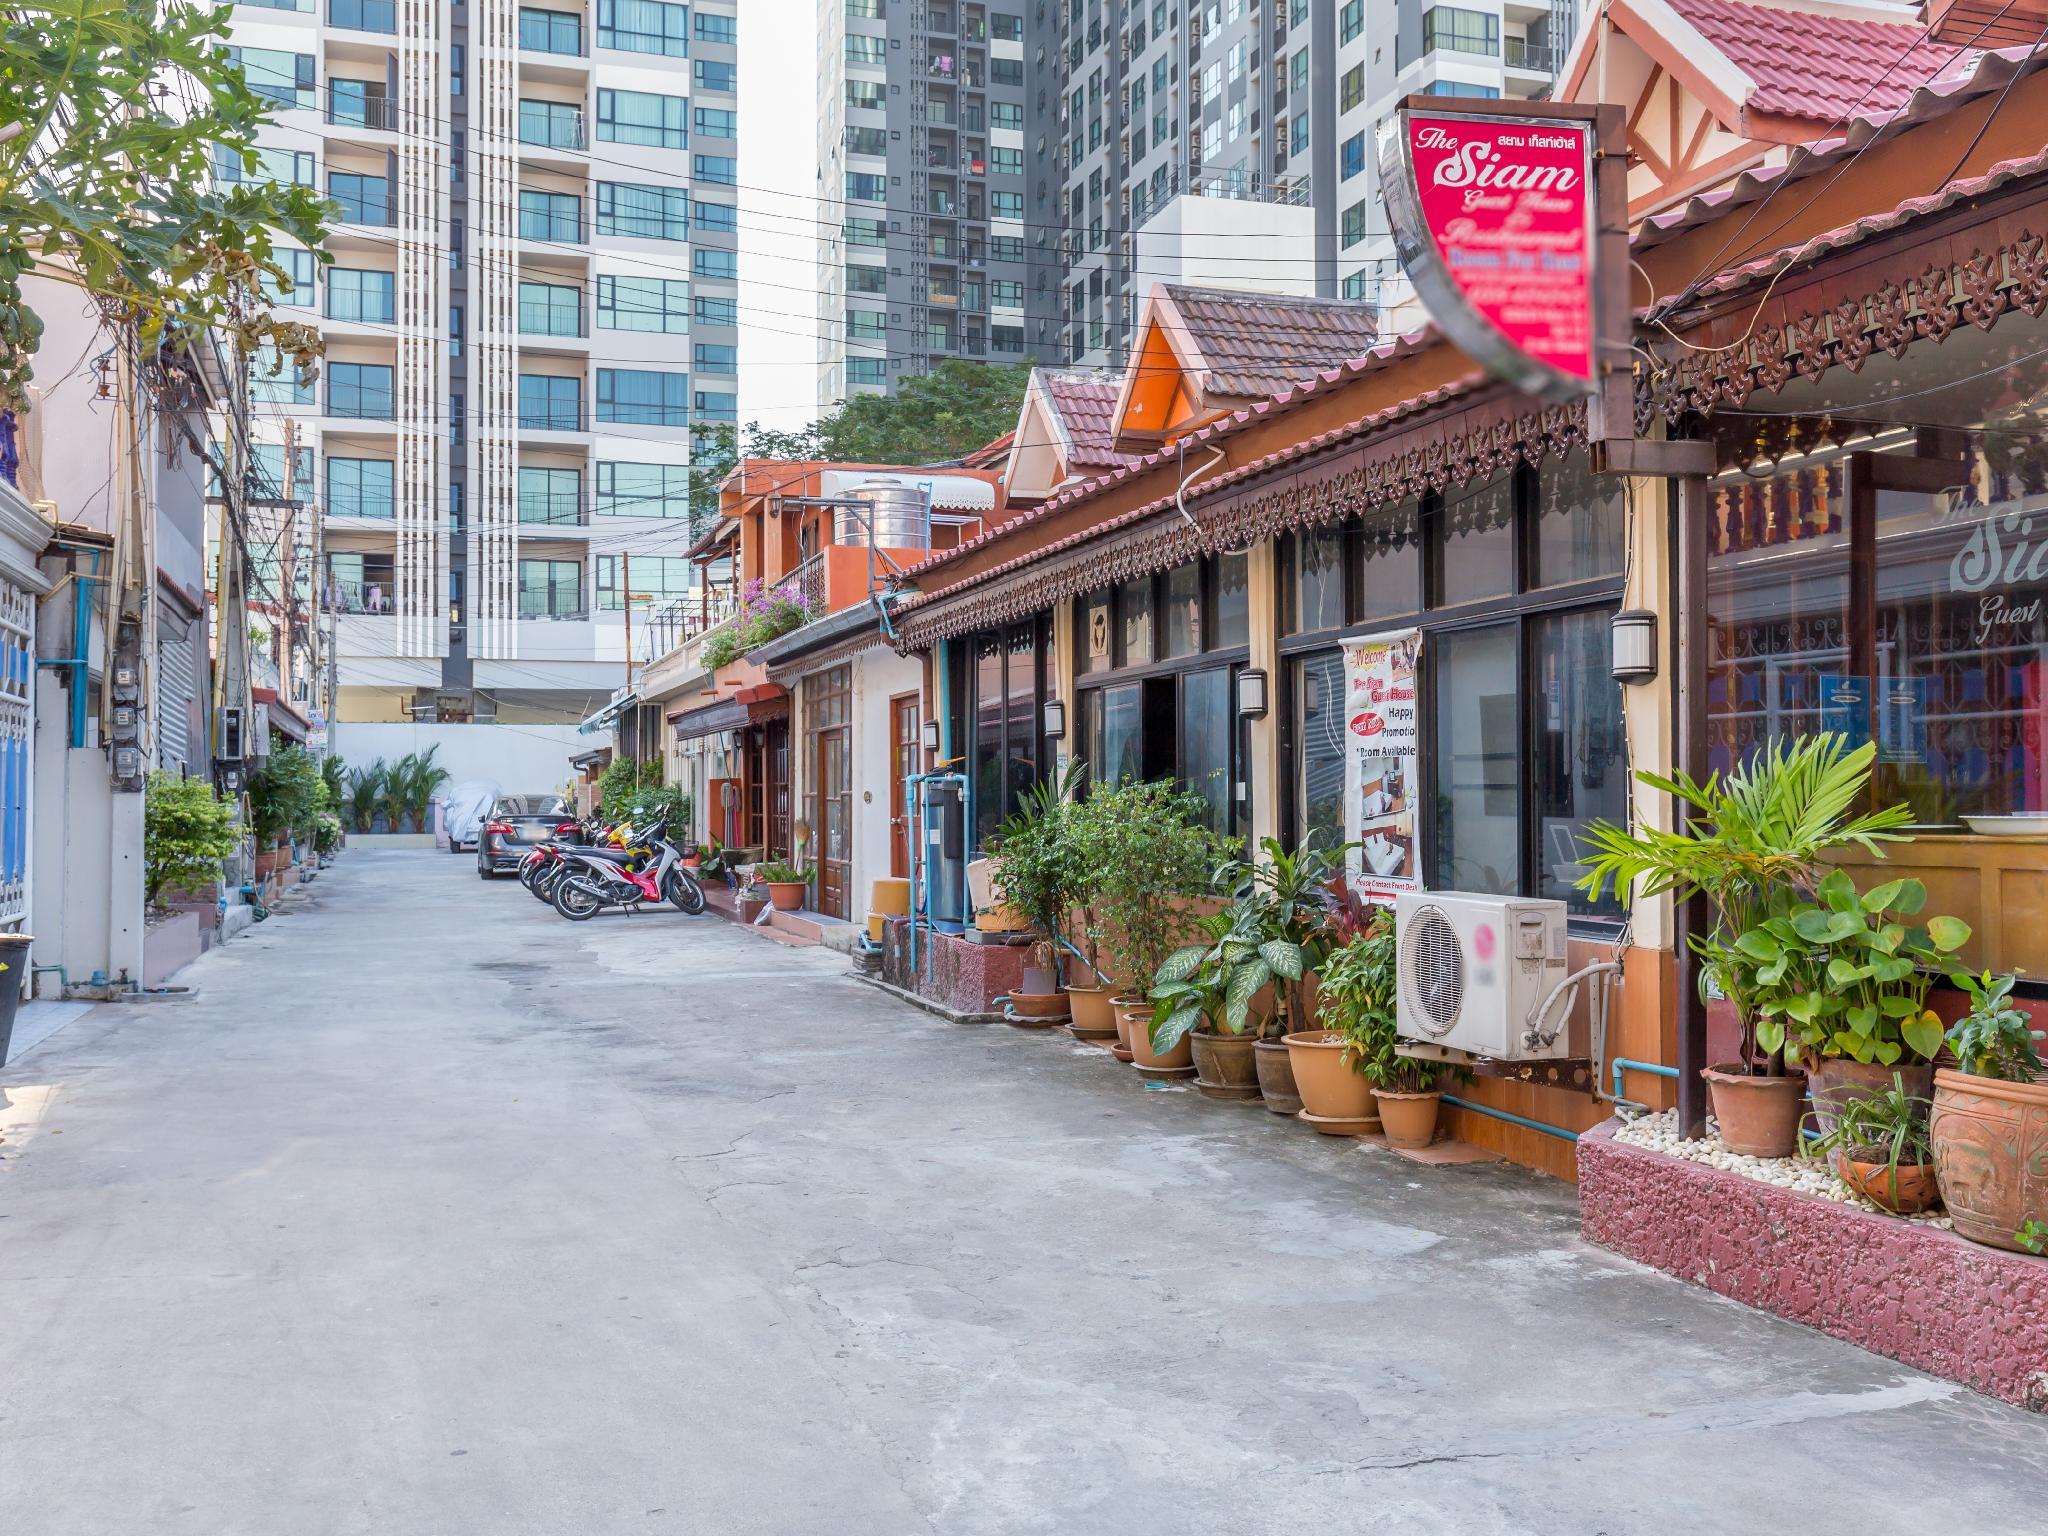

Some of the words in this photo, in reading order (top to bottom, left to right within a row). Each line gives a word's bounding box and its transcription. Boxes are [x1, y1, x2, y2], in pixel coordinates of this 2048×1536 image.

[1416, 127, 1458, 149] The
[1498, 135, 1525, 147] สยาม
[1433, 141, 1580, 191] Siam
[1975, 595, 2041, 645] Guest
[1355, 649, 1387, 666] Welcome
[1371, 690, 1389, 703] Gut
[1390, 686, 1415, 701] House
[1388, 707, 1414, 720] Happy
[1360, 747, 1380, 757] Room
[1381, 745, 1416, 757] Available
[1355, 878, 1371, 887] Please
[1371, 880, 1391, 888] Contact
[1392, 882, 1405, 890] Front
